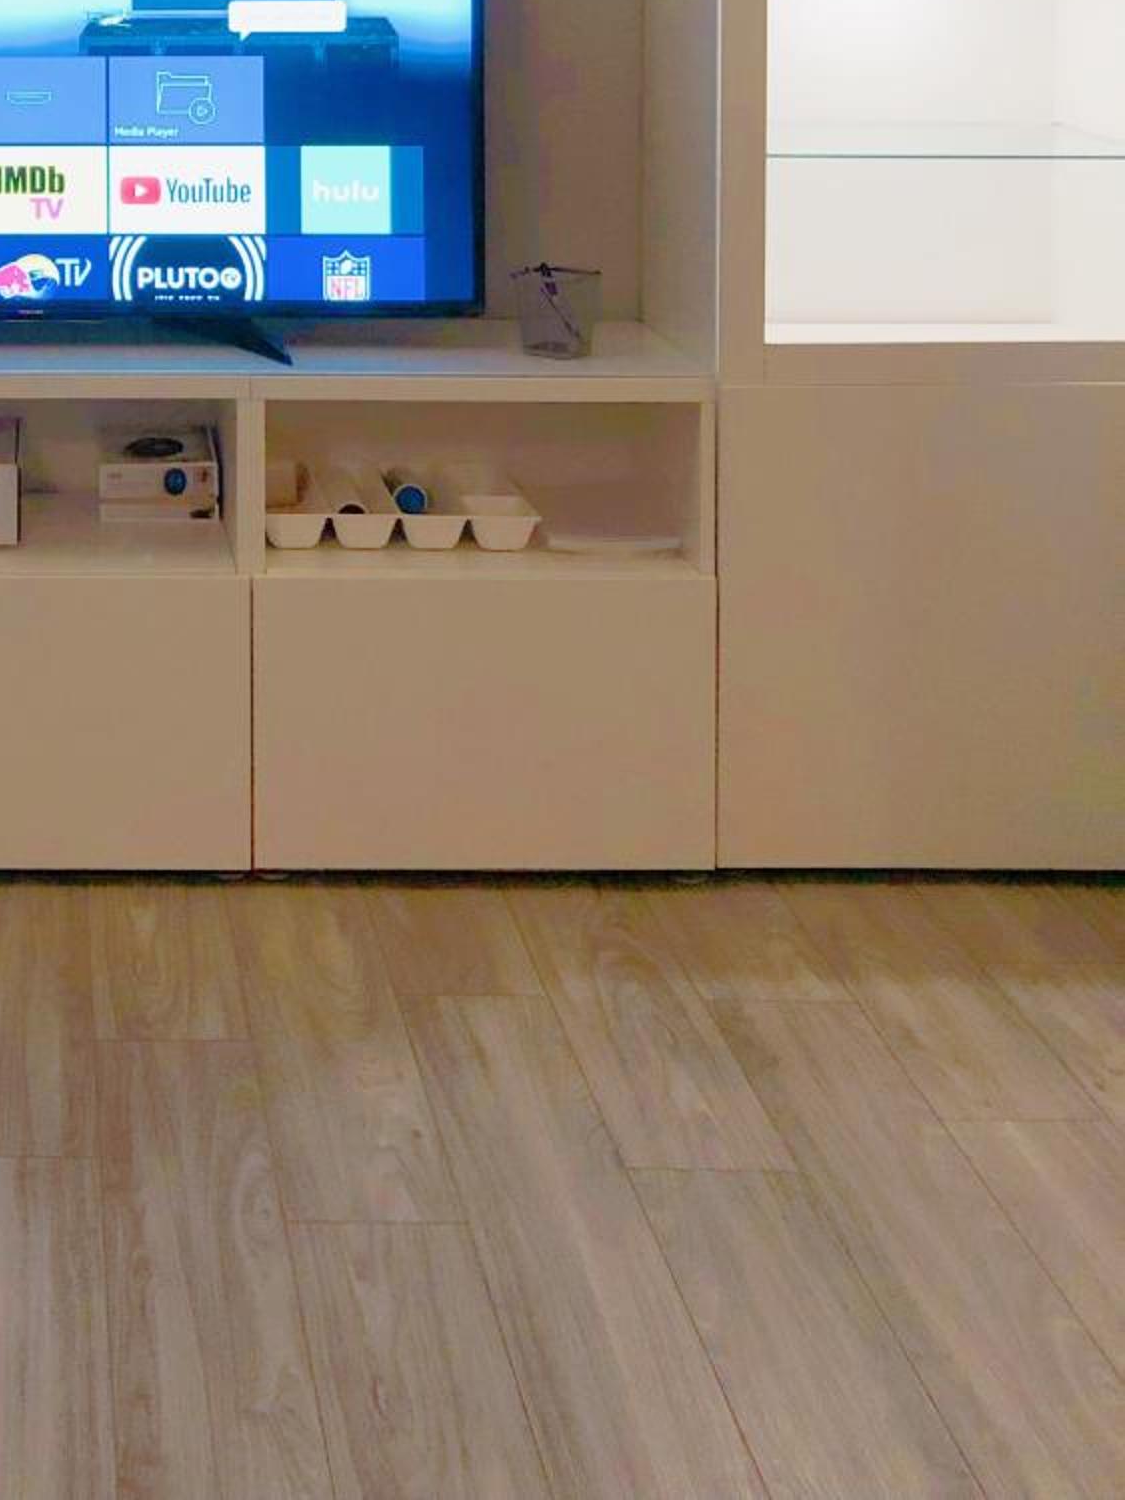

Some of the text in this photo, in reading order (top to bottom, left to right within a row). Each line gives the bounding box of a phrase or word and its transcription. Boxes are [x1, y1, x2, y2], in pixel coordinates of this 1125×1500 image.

[115, 126, 178, 139] Media Player
[166, 178, 252, 204] YouTube
[312, 180, 380, 203] hulu
[30, 198, 64, 220] TV
[56, 258, 91, 286] TV
[330, 278, 365, 299] NFL
